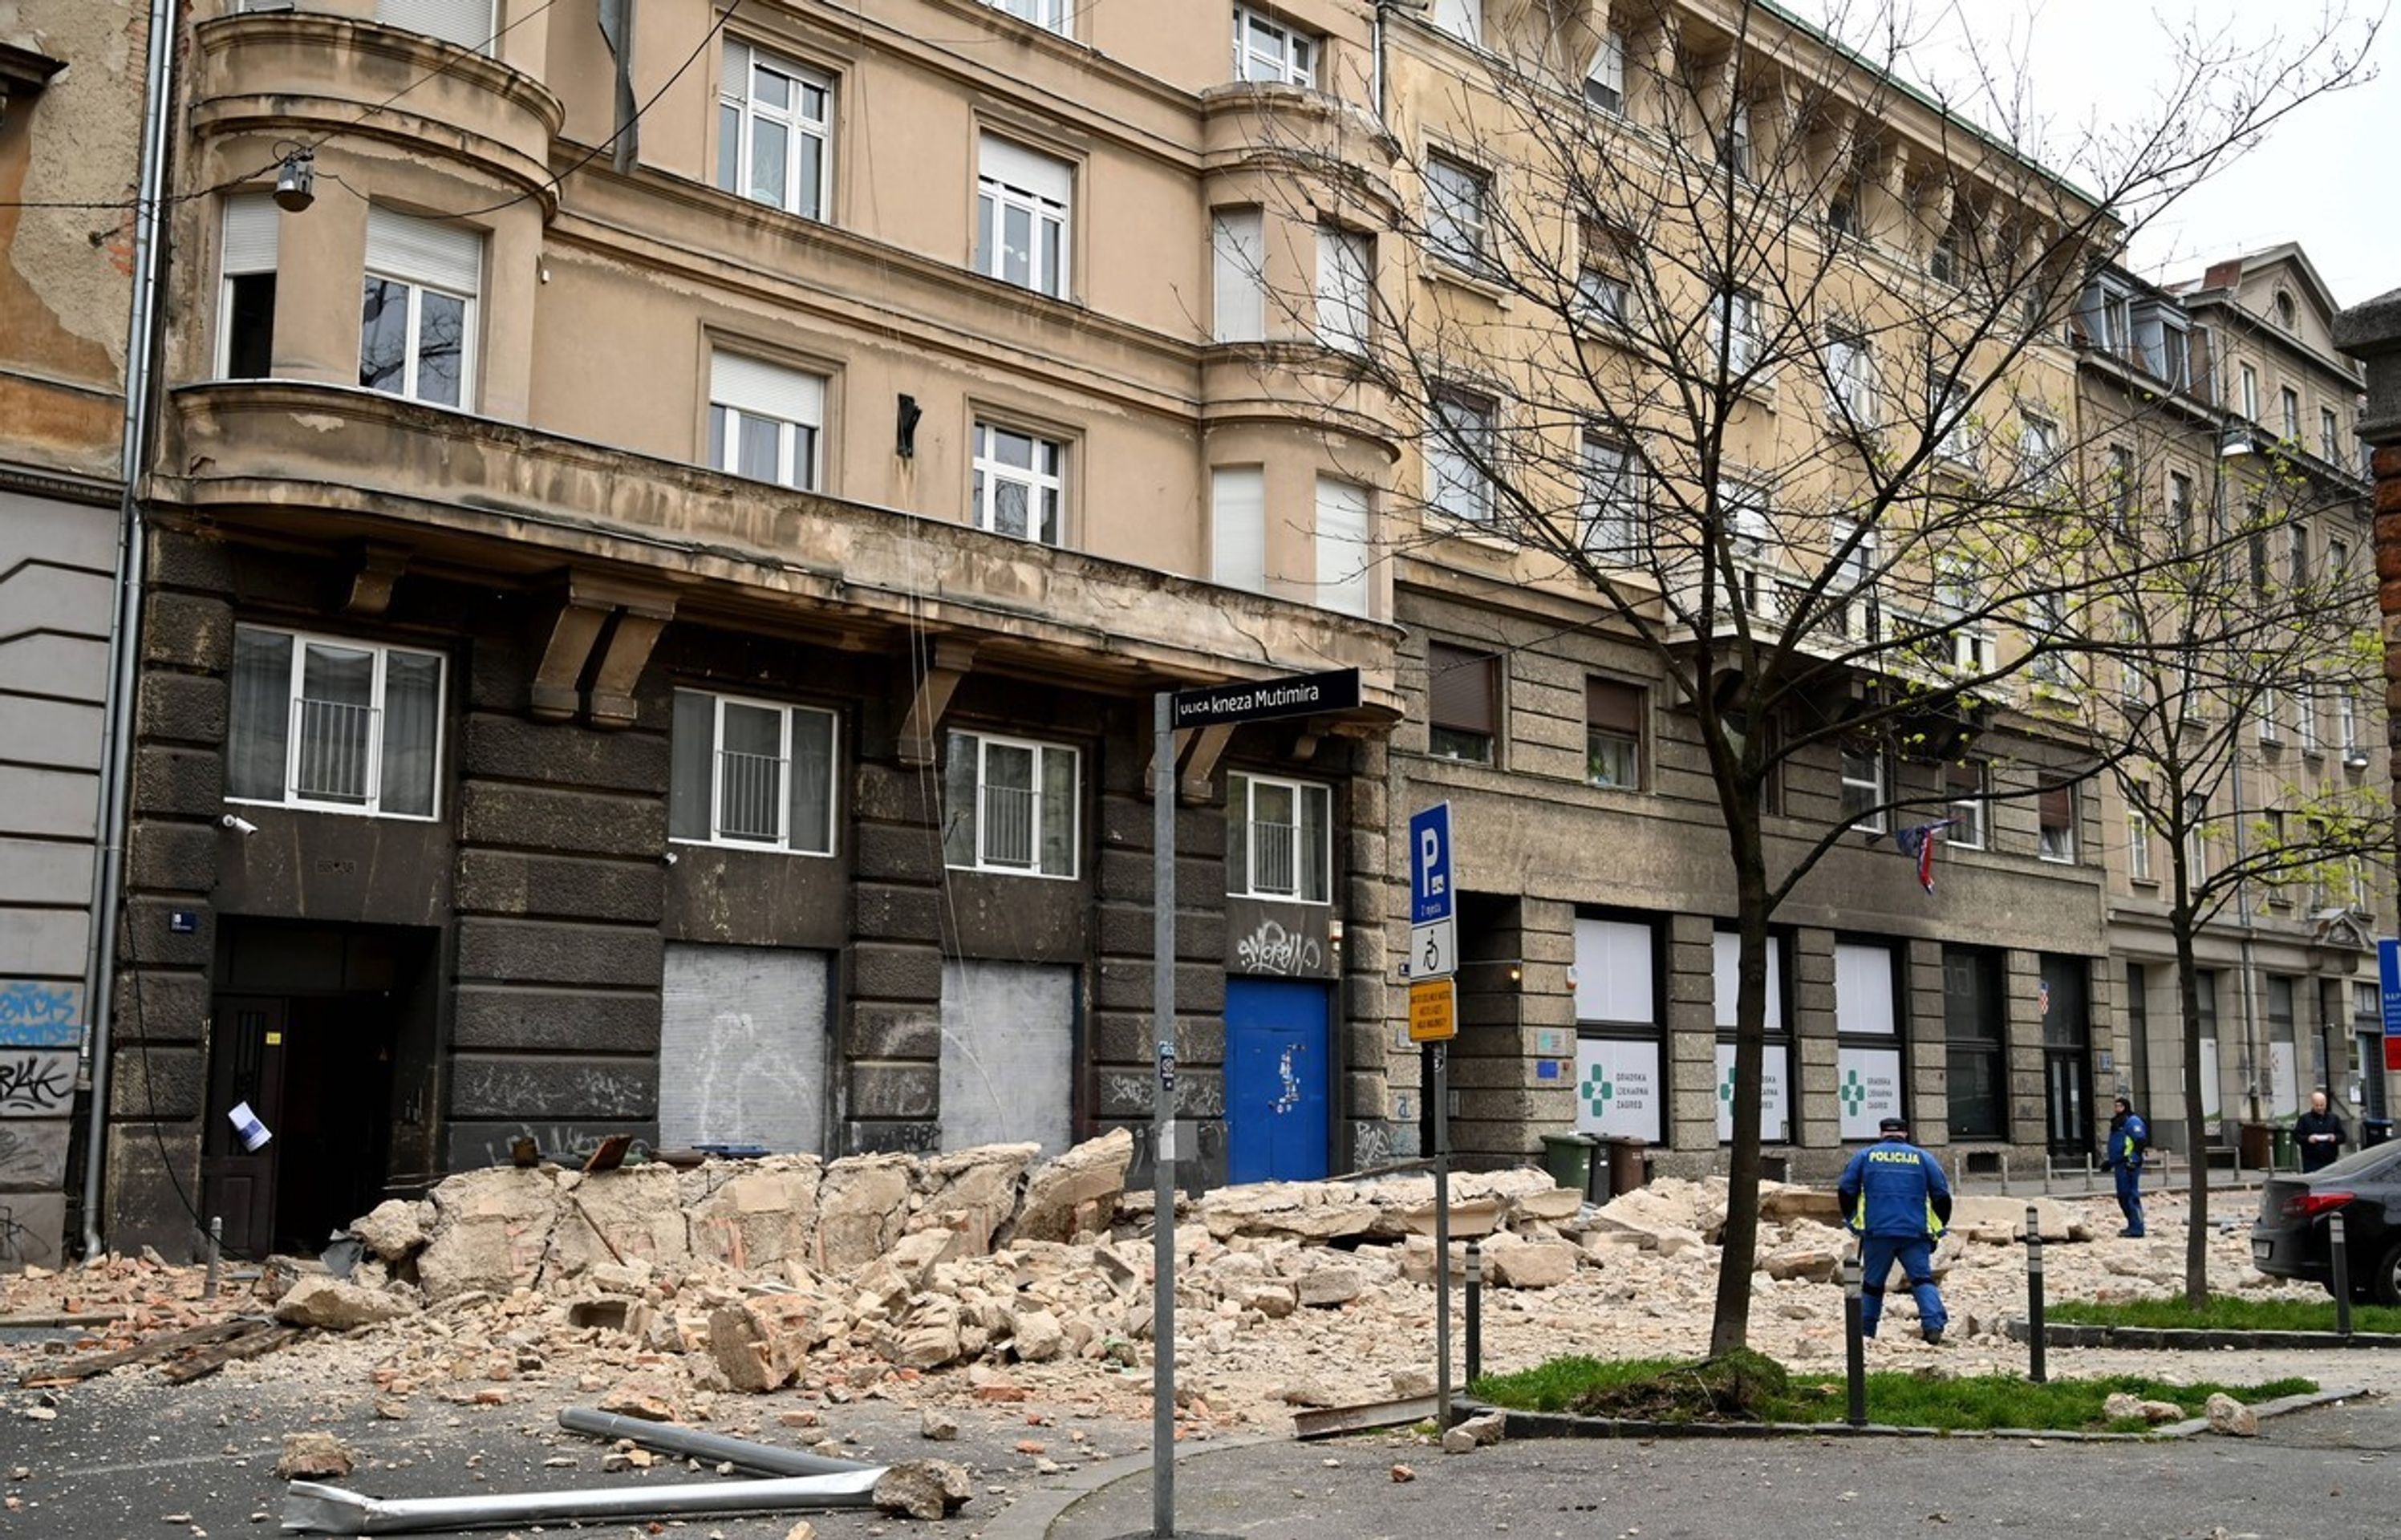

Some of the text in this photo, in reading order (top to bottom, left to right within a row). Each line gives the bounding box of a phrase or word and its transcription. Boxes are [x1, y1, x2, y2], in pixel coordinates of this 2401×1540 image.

[1180, 683, 1320, 715] ULICA kneza Mutimira
[1421, 827, 1439, 898] P
[1868, 1150, 1920, 1165] POLICIJA
